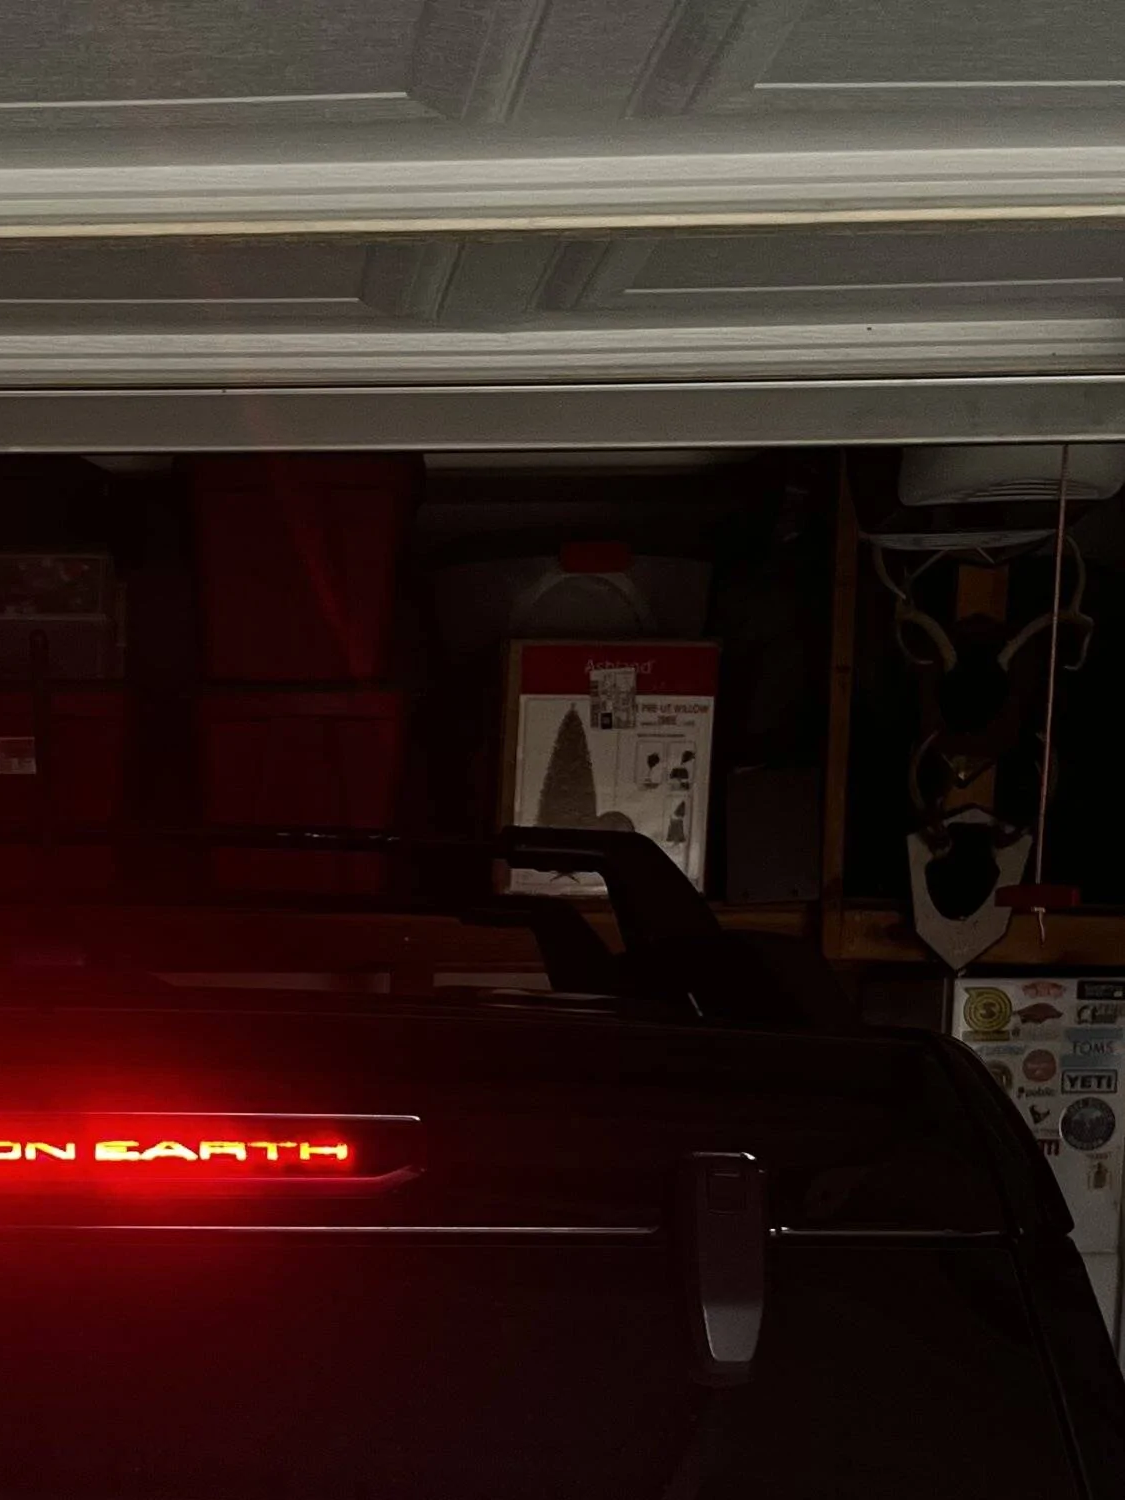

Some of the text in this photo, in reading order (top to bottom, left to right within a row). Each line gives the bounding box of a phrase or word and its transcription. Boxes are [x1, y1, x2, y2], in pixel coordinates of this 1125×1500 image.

[1072, 1041, 1115, 1056] TOMS
[1066, 1074, 1113, 1090] YETI
[95, 1141, 349, 1161] EARTH
